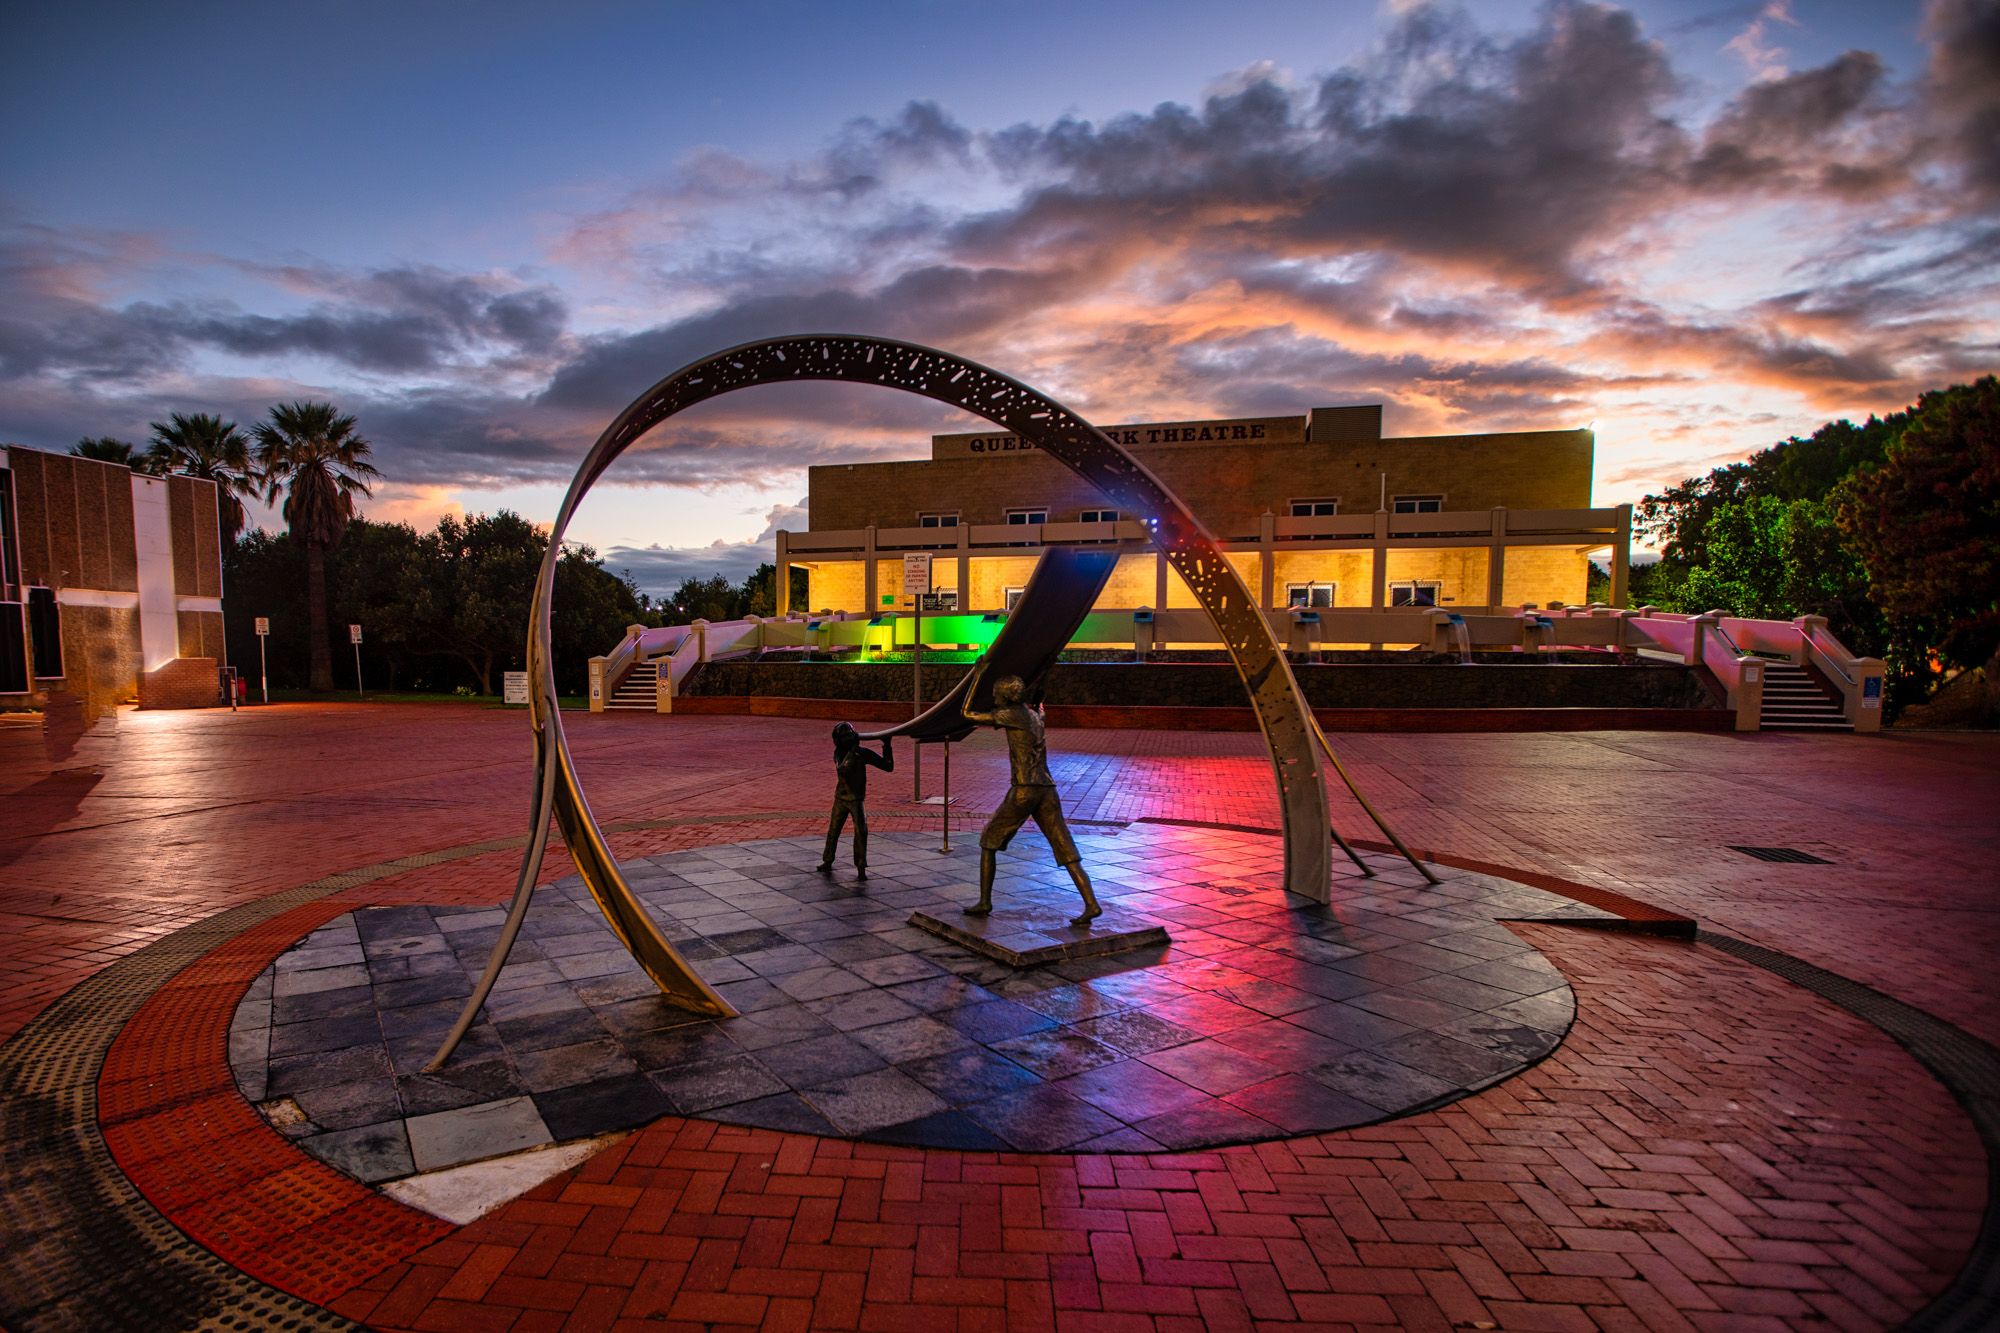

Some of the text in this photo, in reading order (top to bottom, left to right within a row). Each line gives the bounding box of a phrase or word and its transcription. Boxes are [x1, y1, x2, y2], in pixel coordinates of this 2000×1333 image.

[970, 424, 1265, 452] QUEE RK THEATRE
